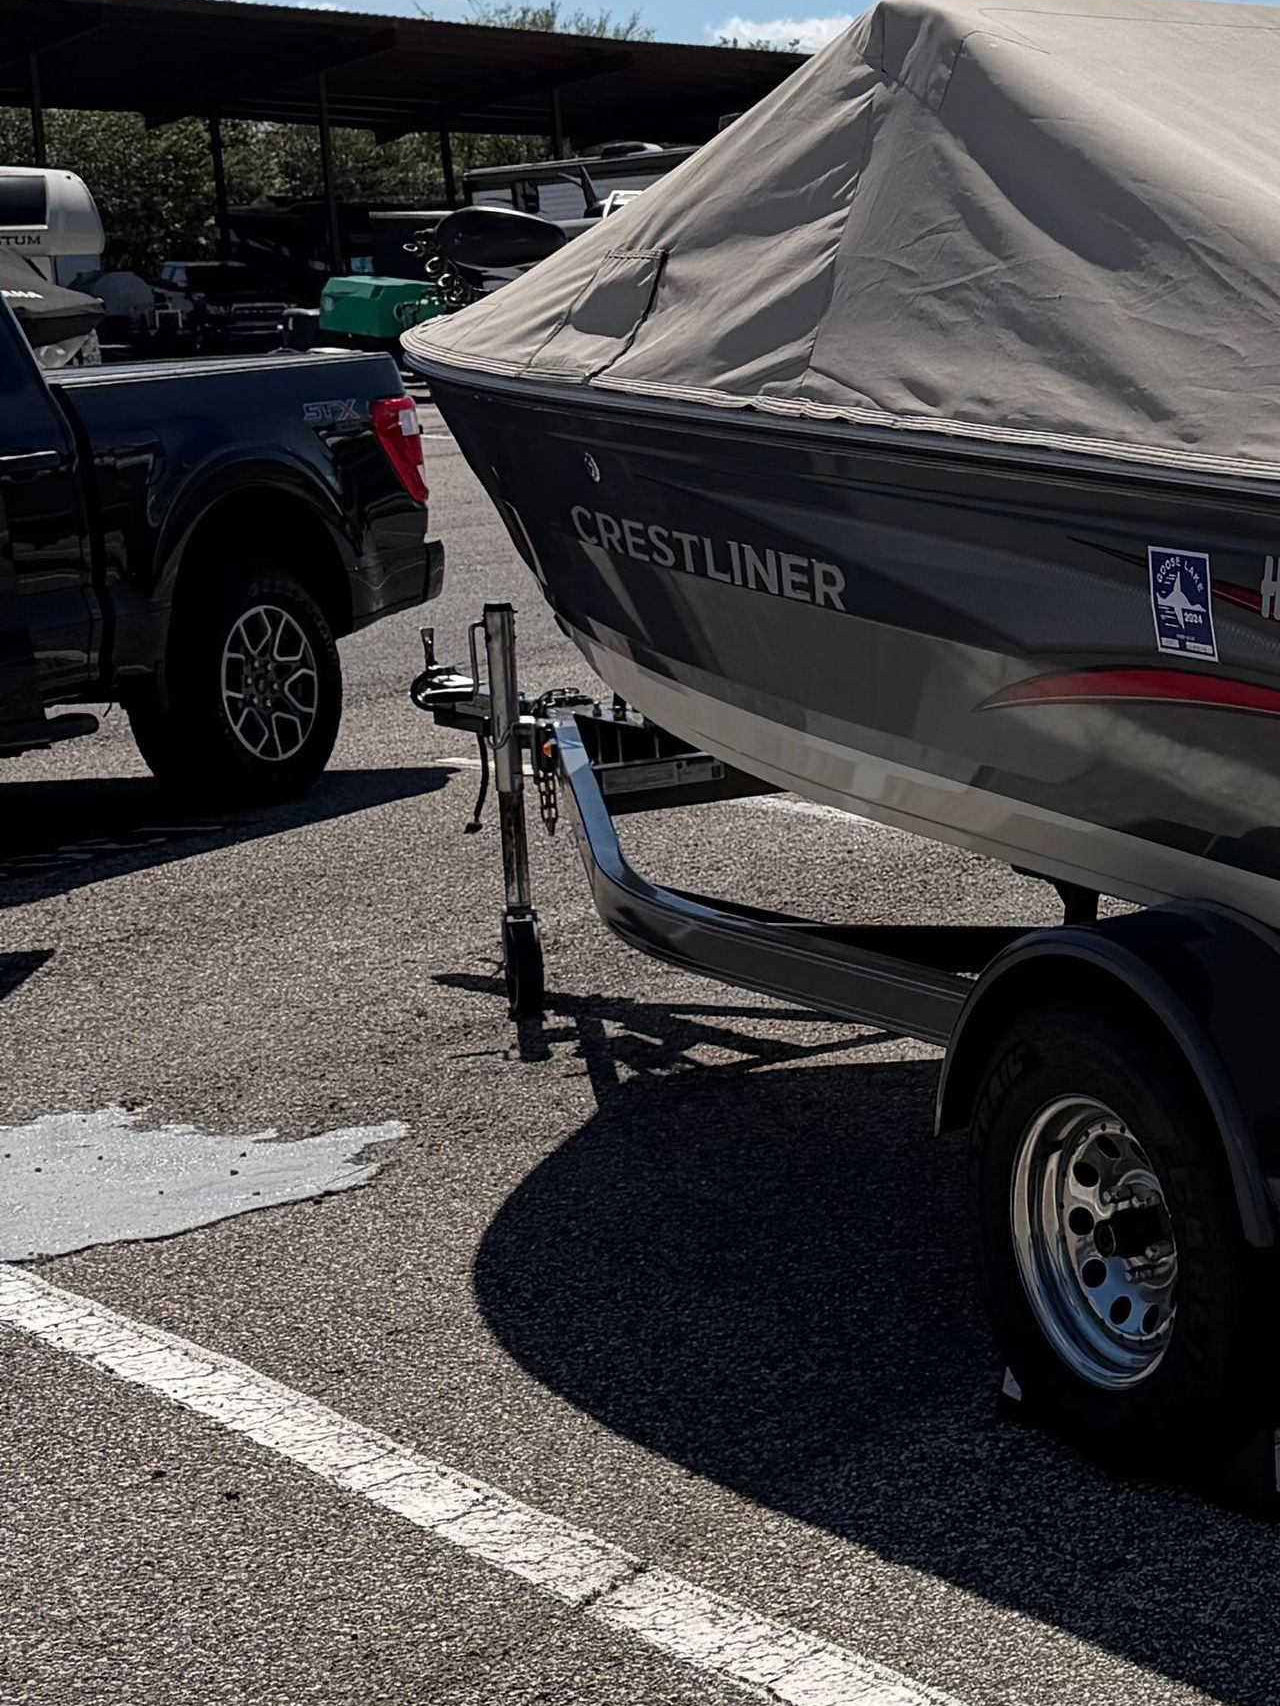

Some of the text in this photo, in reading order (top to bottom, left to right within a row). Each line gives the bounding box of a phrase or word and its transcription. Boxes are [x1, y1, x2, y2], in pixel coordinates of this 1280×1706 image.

[0, 235, 41, 245] TUM
[570, 504, 847, 611] CRESTLINER
[1183, 560, 1205, 593] LAKE
[1184, 612, 1203, 624] 2024
